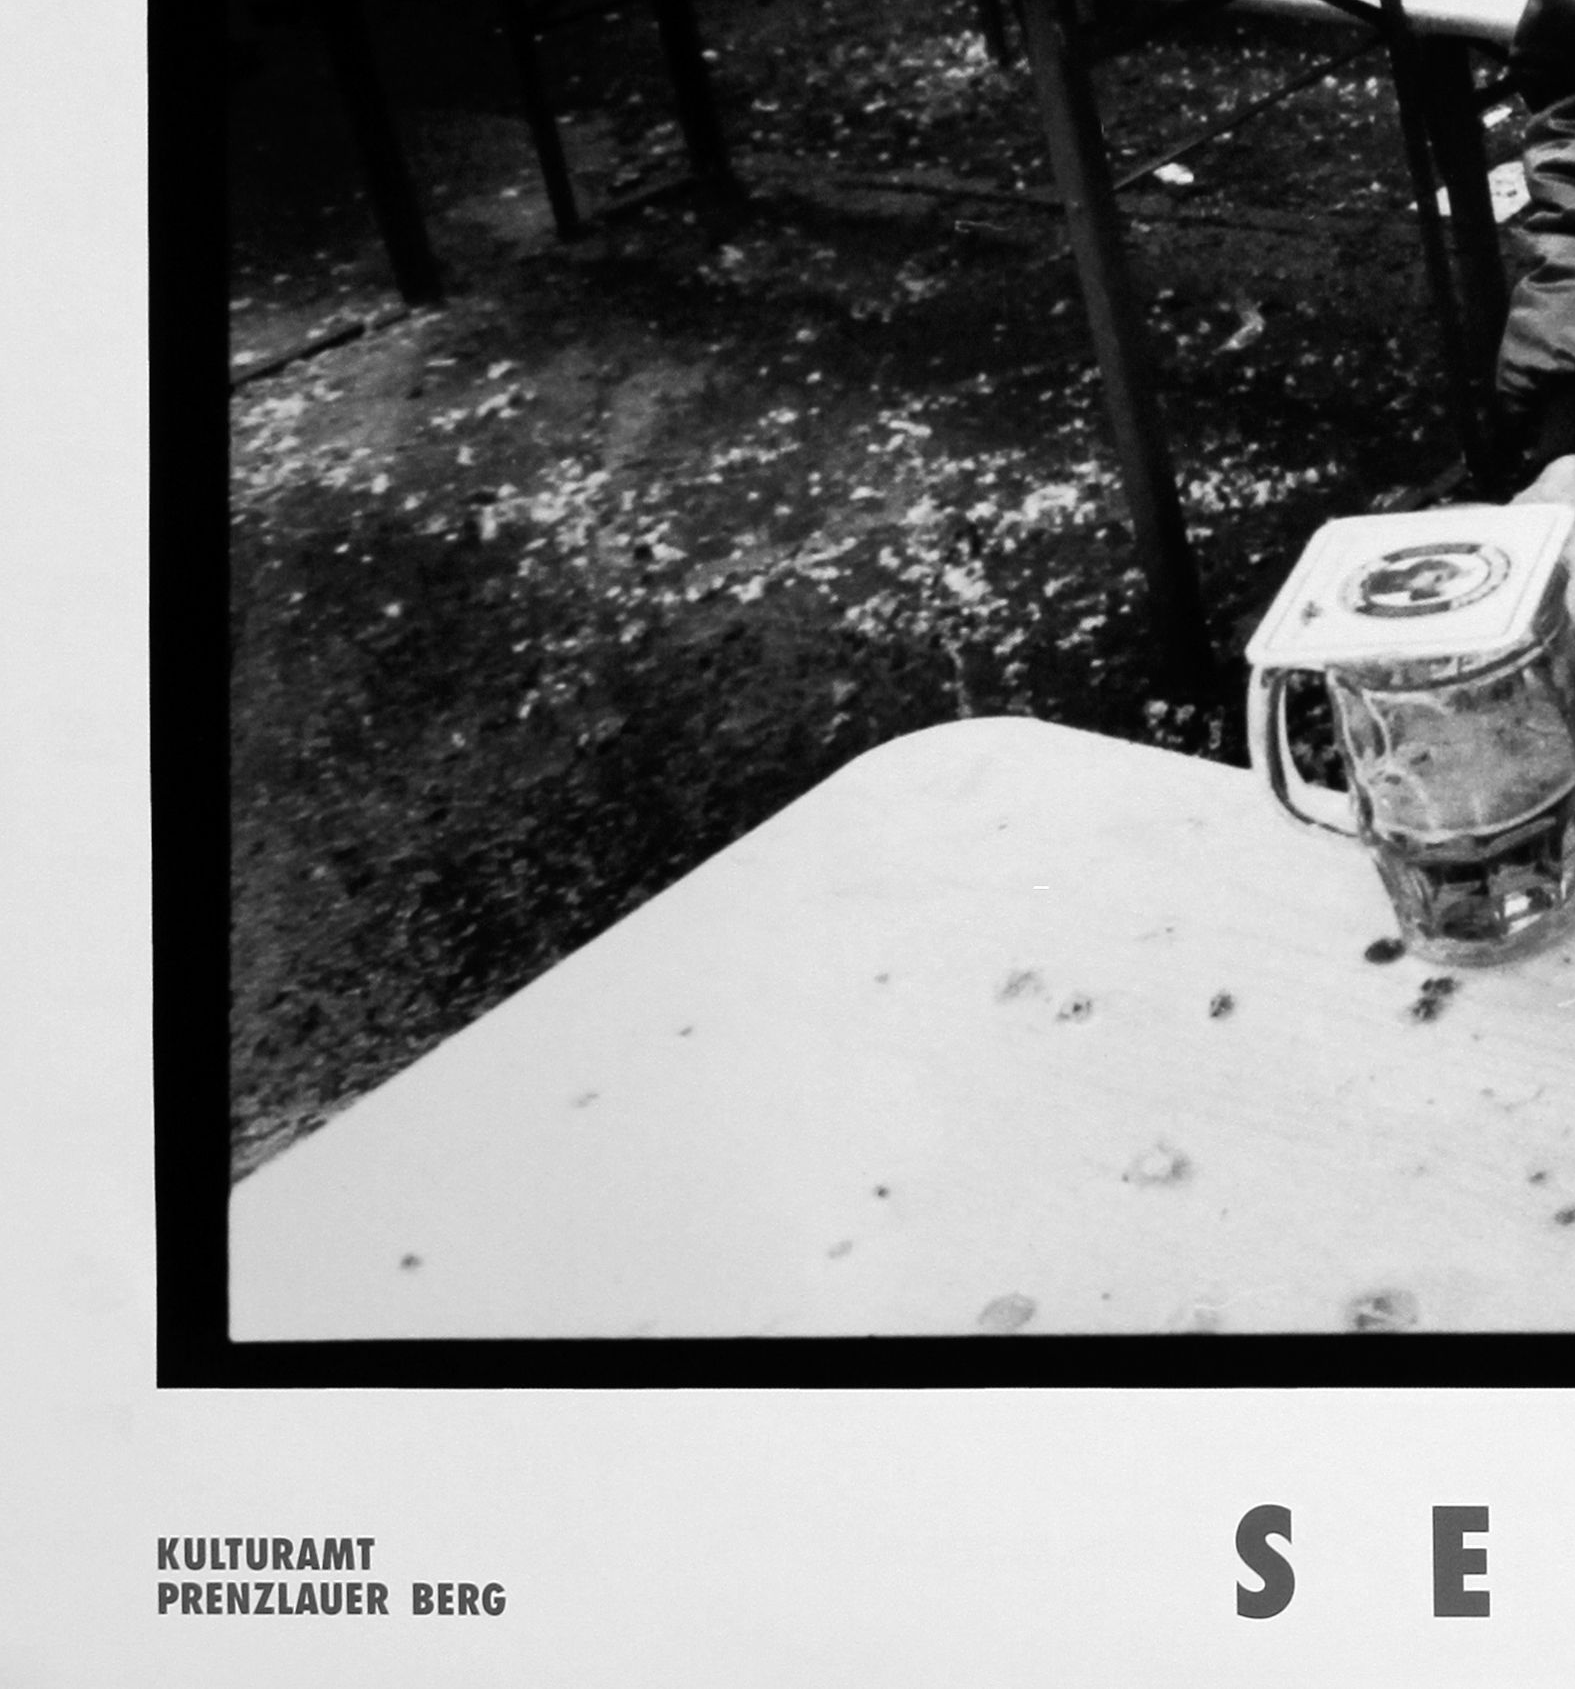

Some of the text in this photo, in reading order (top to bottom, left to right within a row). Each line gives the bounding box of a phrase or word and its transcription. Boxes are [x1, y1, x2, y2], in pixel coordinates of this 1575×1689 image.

[157, 1537, 375, 1571] KULTURAMT
[157, 1582, 506, 1617] PRENZLAUER BERG
